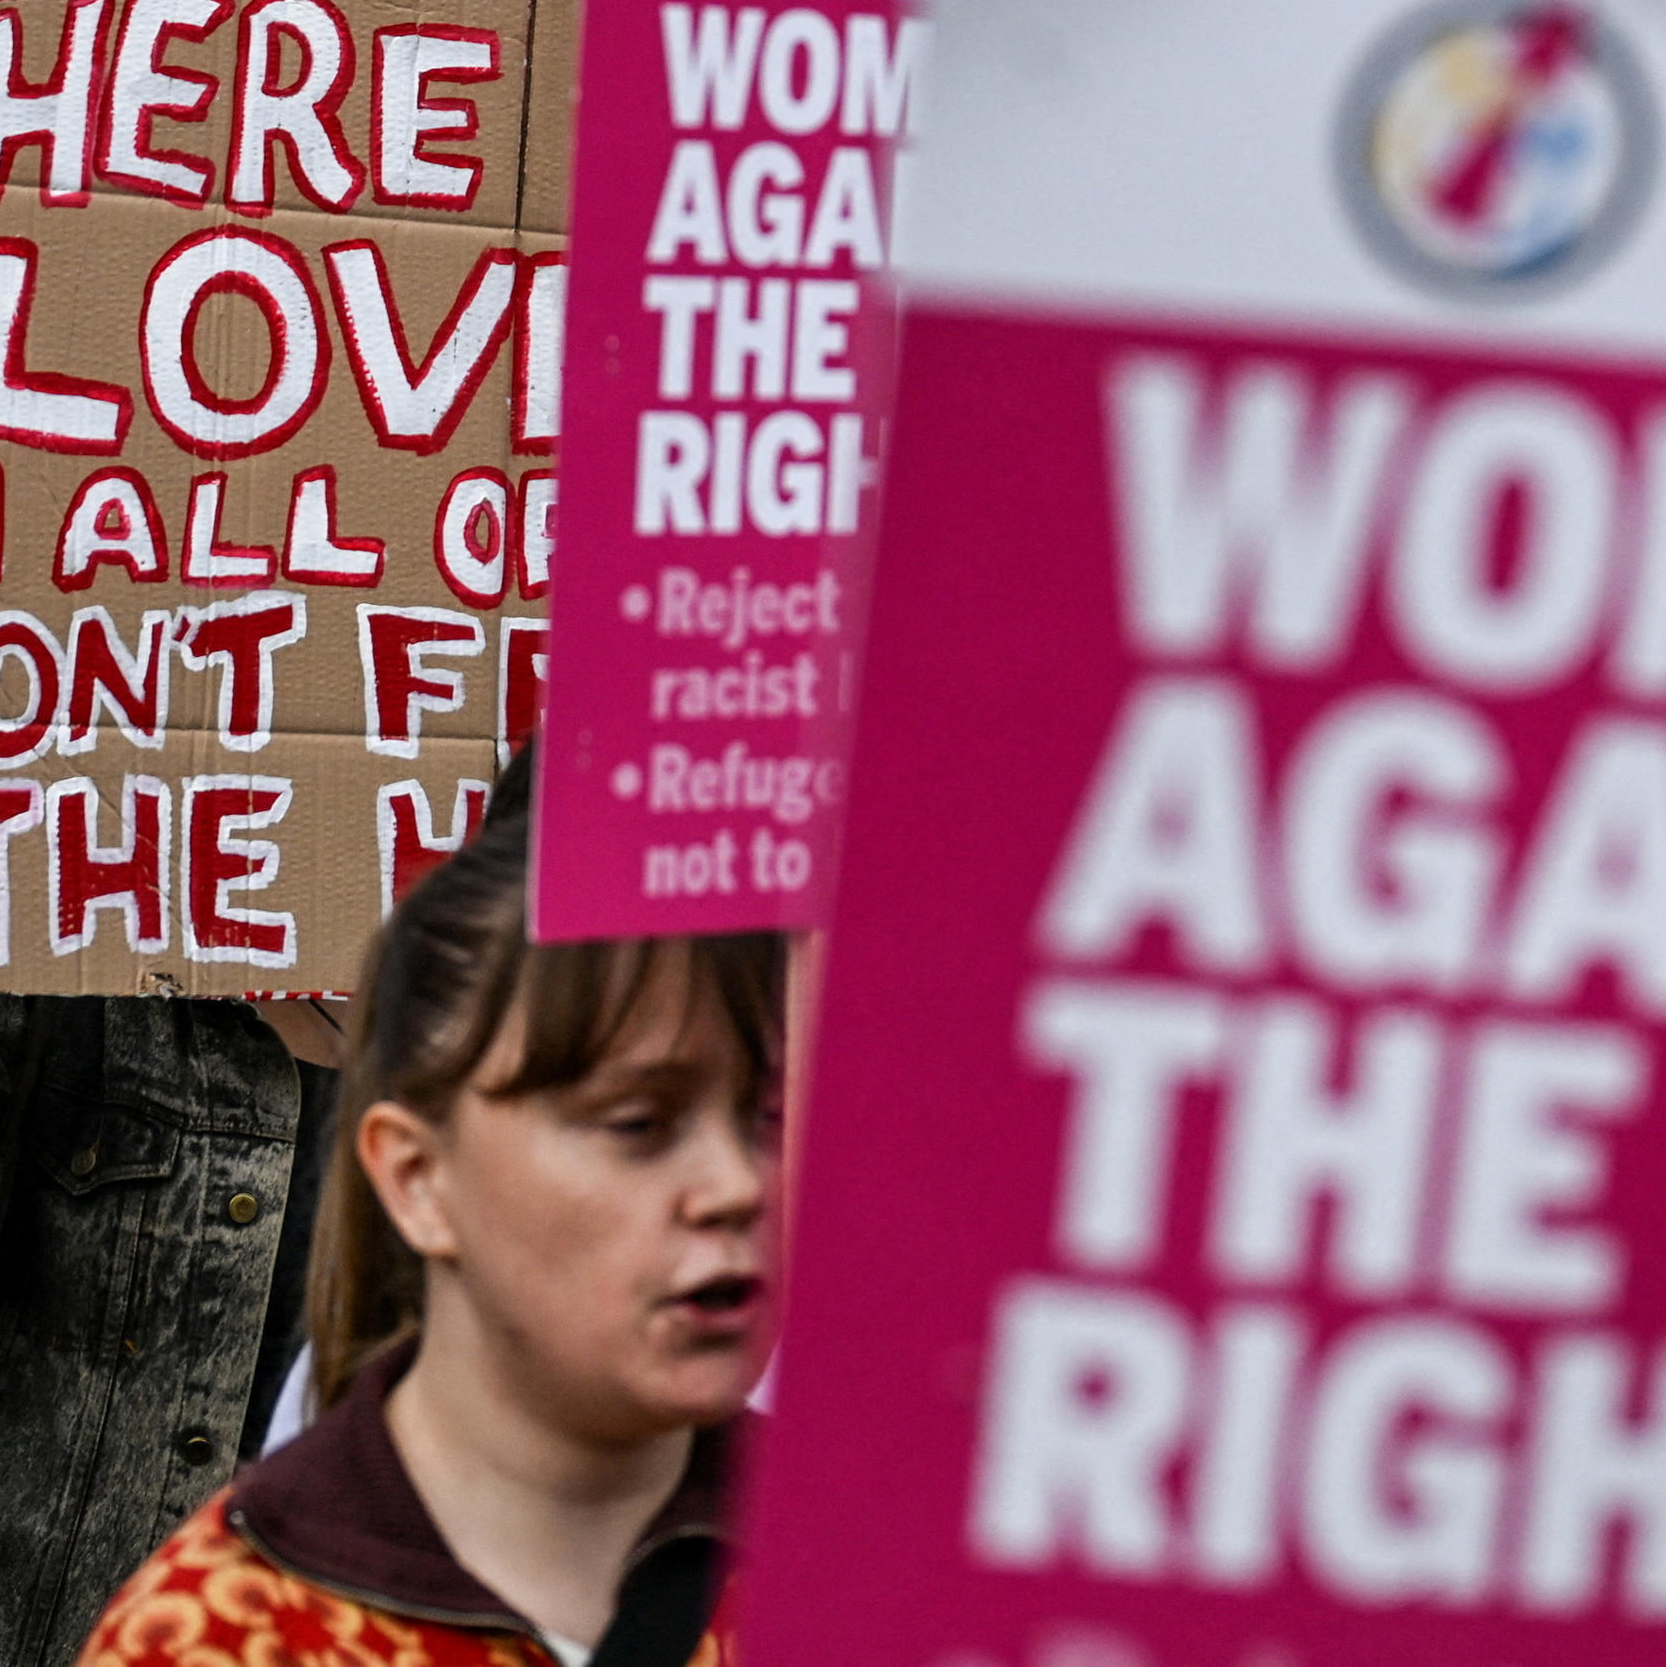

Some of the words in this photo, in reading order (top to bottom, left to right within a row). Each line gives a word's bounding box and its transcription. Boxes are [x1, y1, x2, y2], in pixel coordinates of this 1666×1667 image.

[641, 273, 860, 401] THE
[51, 463, 386, 593] ALL
[656, 565, 841, 652] Reject
[649, 650, 819, 721] racist
[643, 830, 735, 900] not
[750, 830, 813, 892] to
[1016, 974, 1655, 1319] THE
